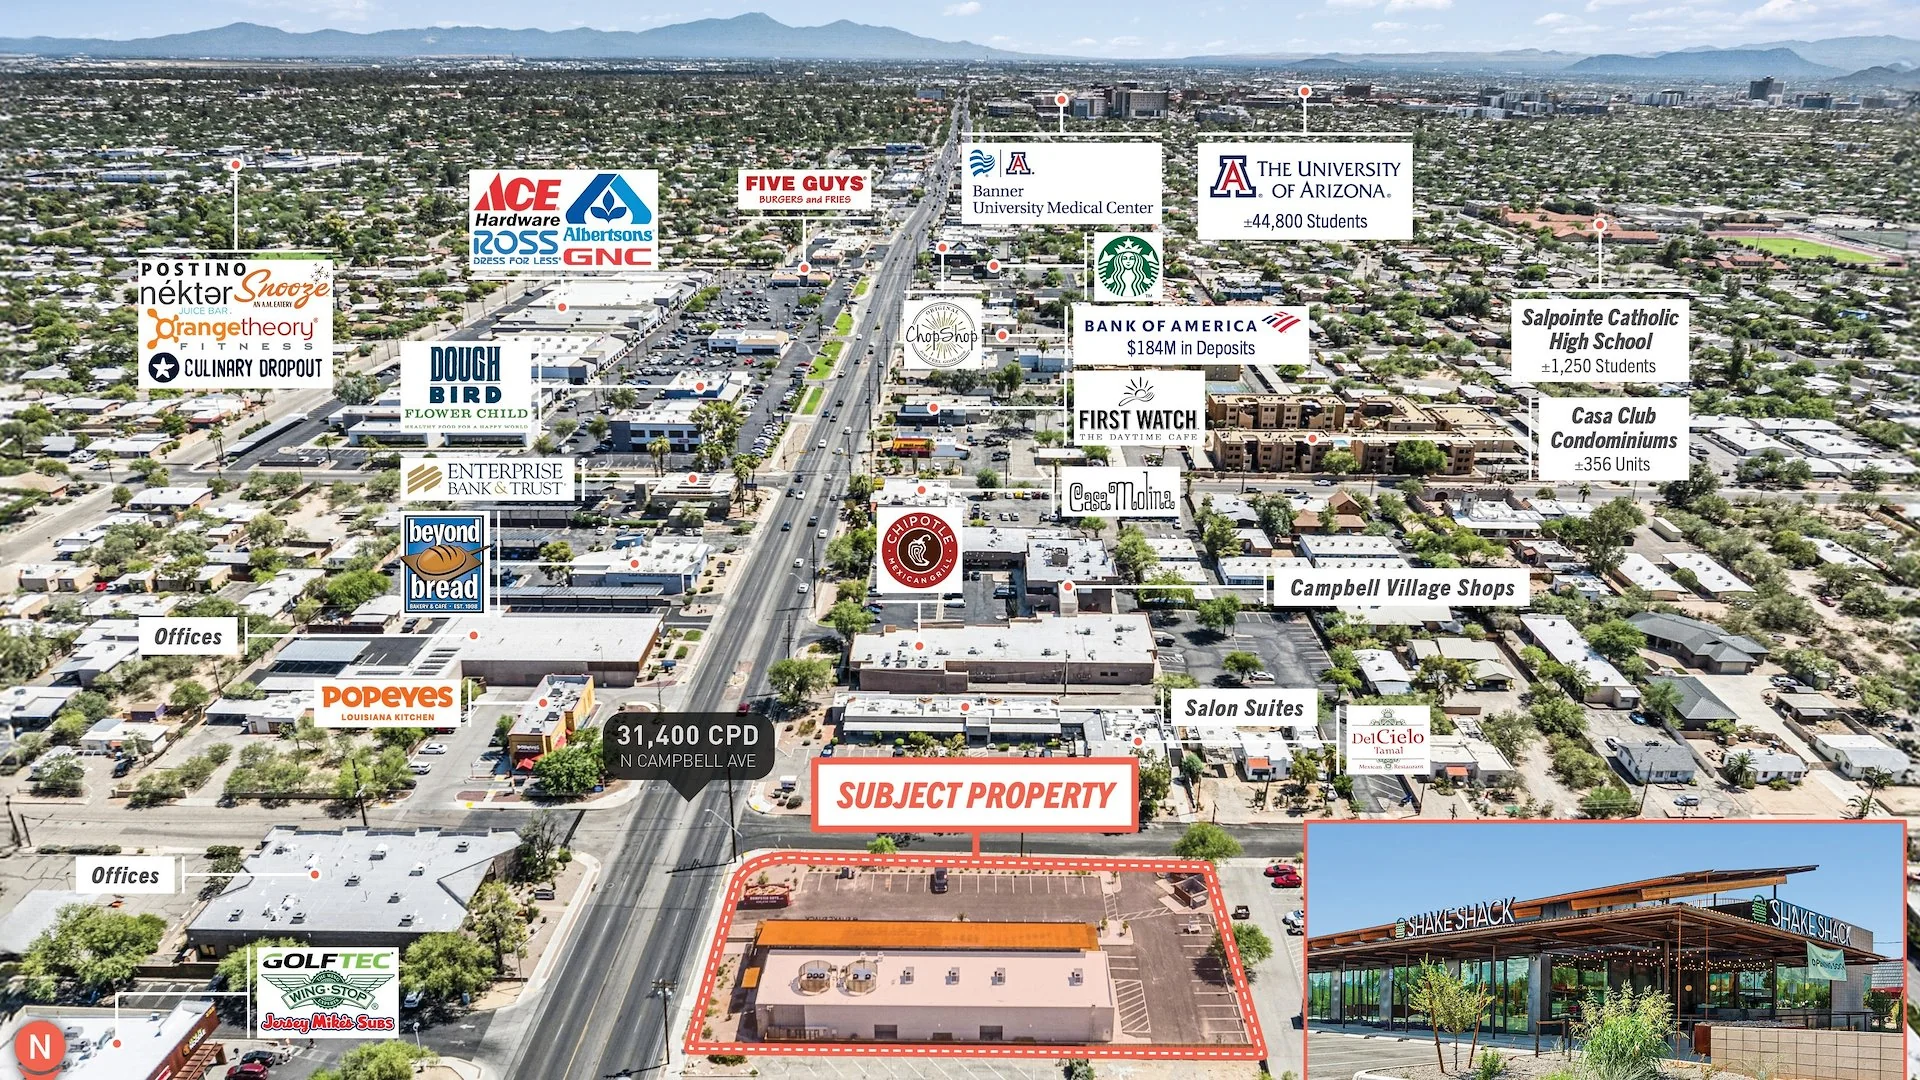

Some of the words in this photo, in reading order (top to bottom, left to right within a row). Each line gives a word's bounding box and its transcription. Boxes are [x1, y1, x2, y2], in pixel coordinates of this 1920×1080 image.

[1407, 907, 1454, 936] SHAKE
[1455, 897, 1516, 931] SHACK
[1770, 899, 1816, 937] SHAKE
[1817, 915, 1852, 946] SHACK
